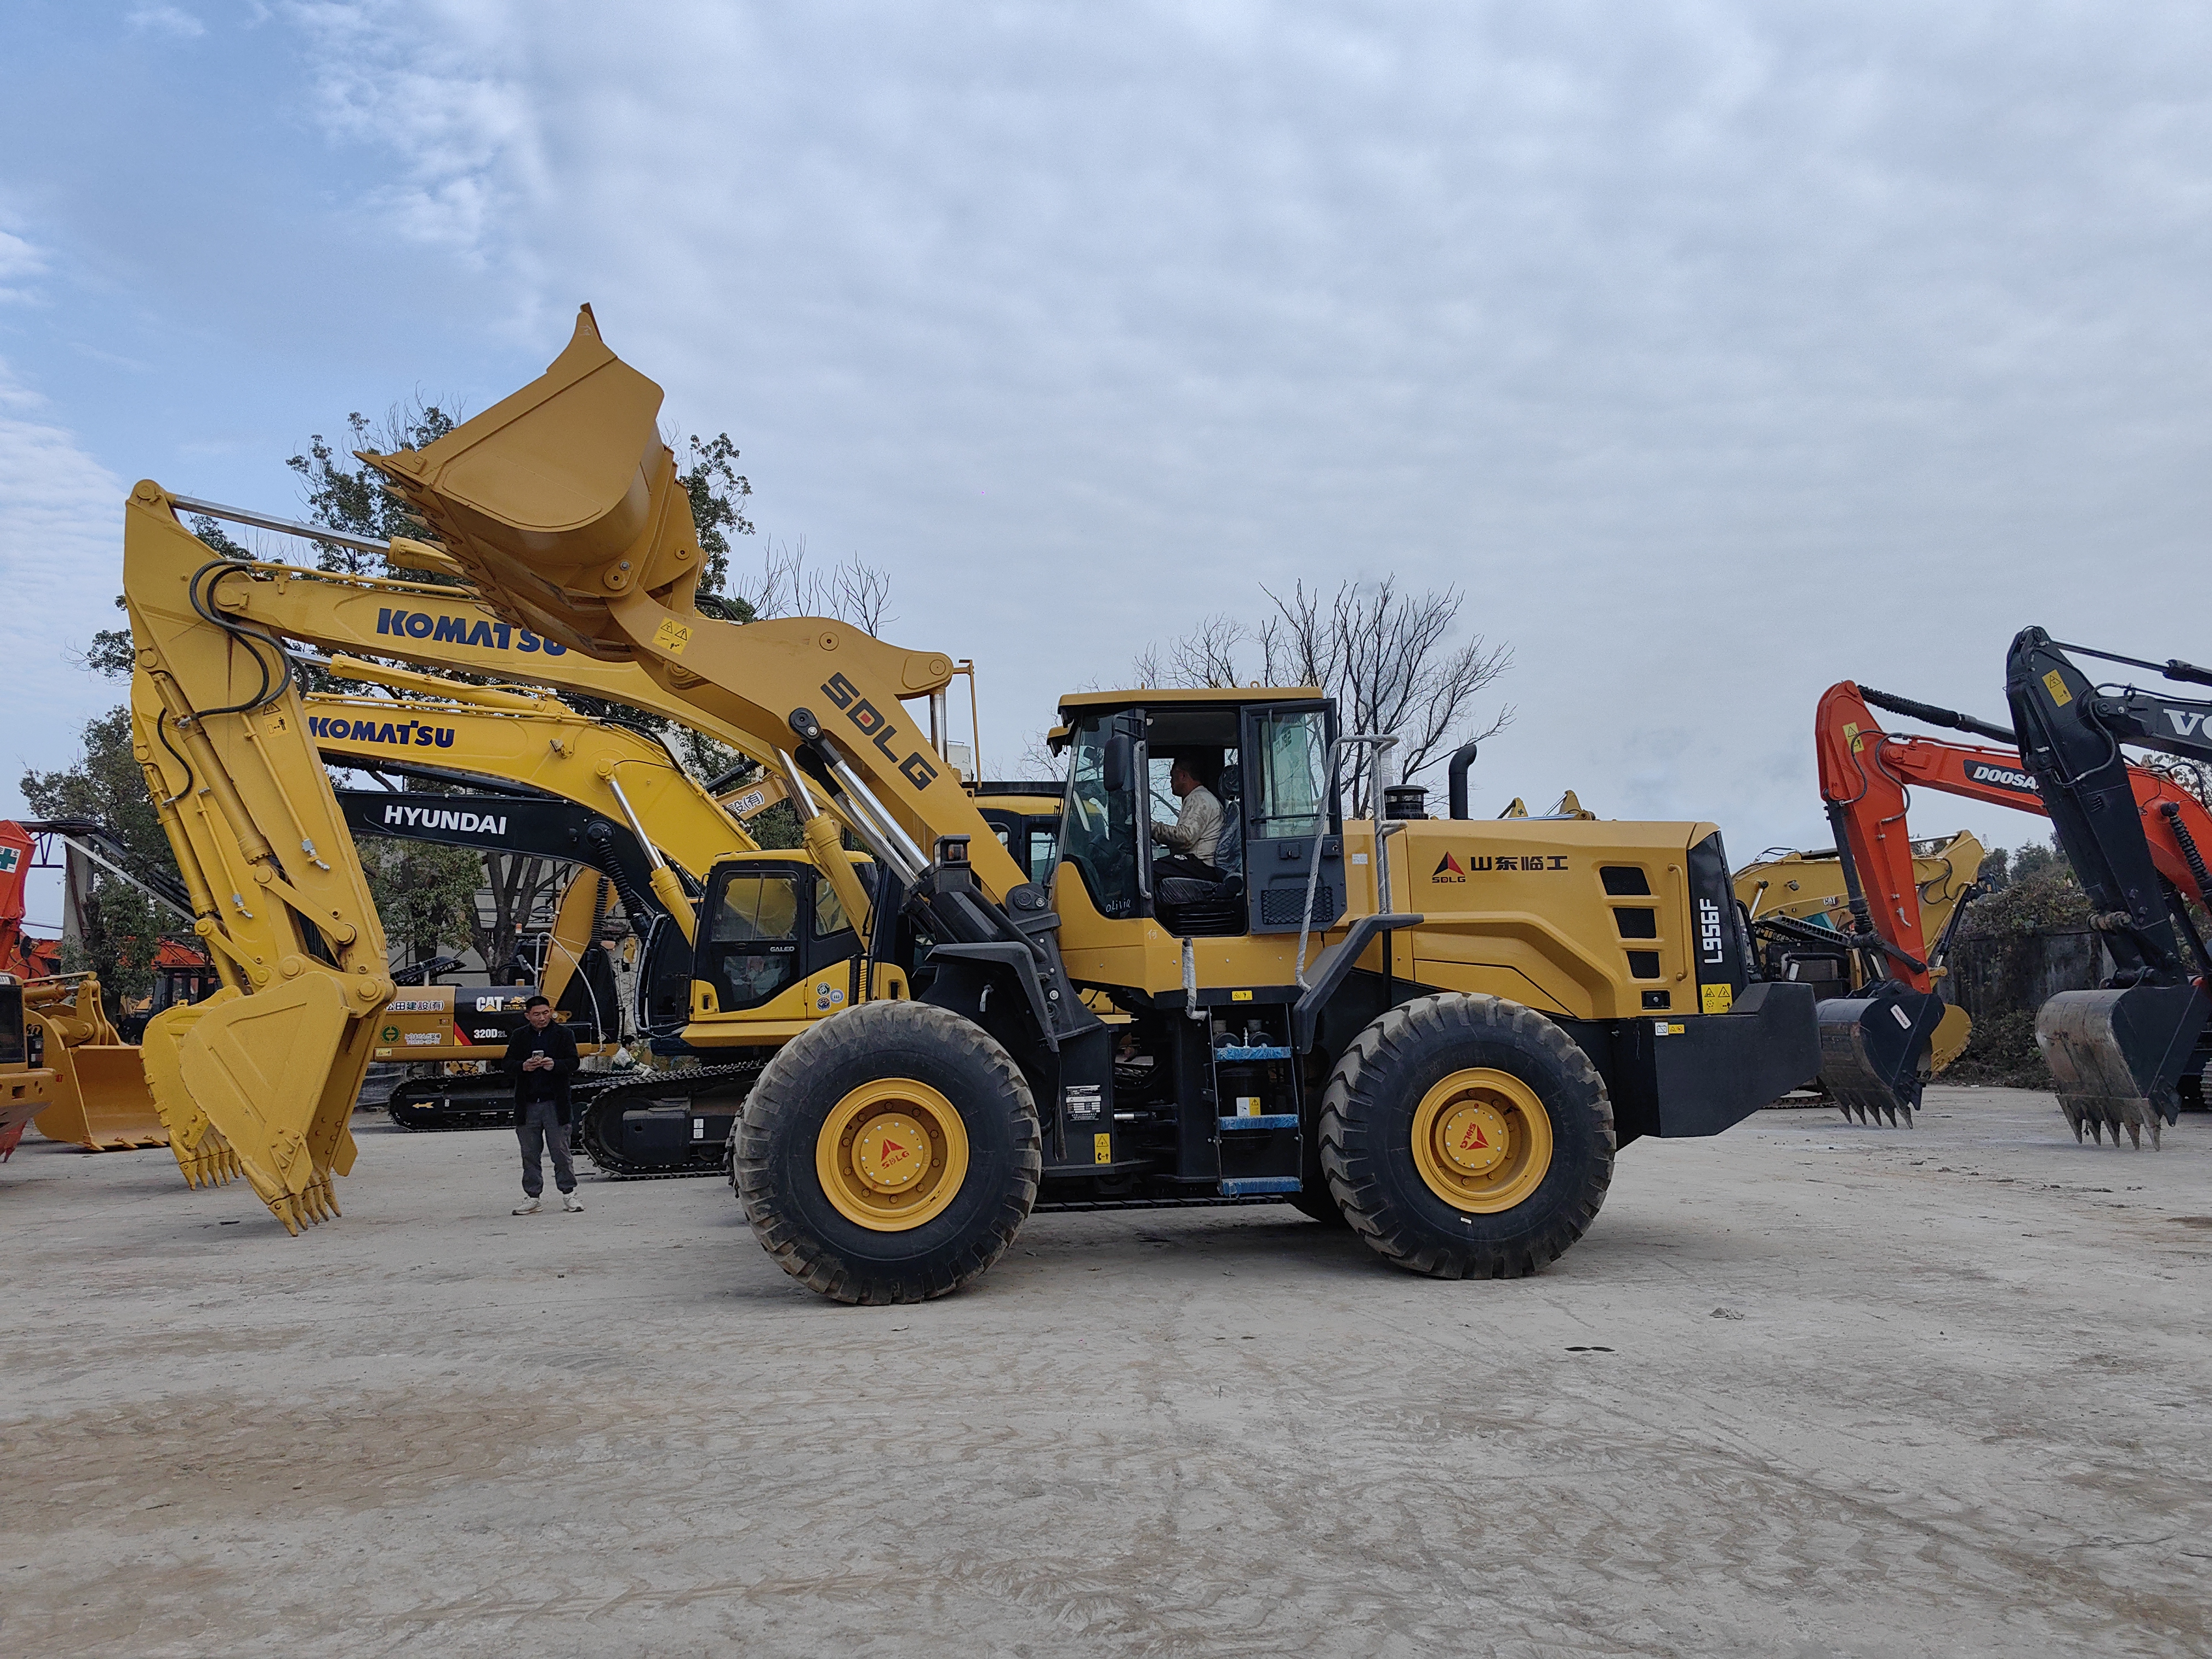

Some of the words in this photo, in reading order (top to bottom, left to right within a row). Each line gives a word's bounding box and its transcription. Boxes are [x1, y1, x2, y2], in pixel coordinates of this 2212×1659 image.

[377, 608, 567, 656] KOMATSU
[309, 716, 455, 748] KOMATSU
[820, 672, 938, 791] SDLG
[1973, 766, 2039, 790] DOOSA
[384, 805, 507, 834] HYUNDAI
[1471, 855, 1568, 871] 山东临工
[1699, 899, 1723, 963] L956F
[476, 996, 504, 1012] CAT
[1460, 1122, 1476, 1149] SDLG
[882, 1151, 910, 1169] SDLG
